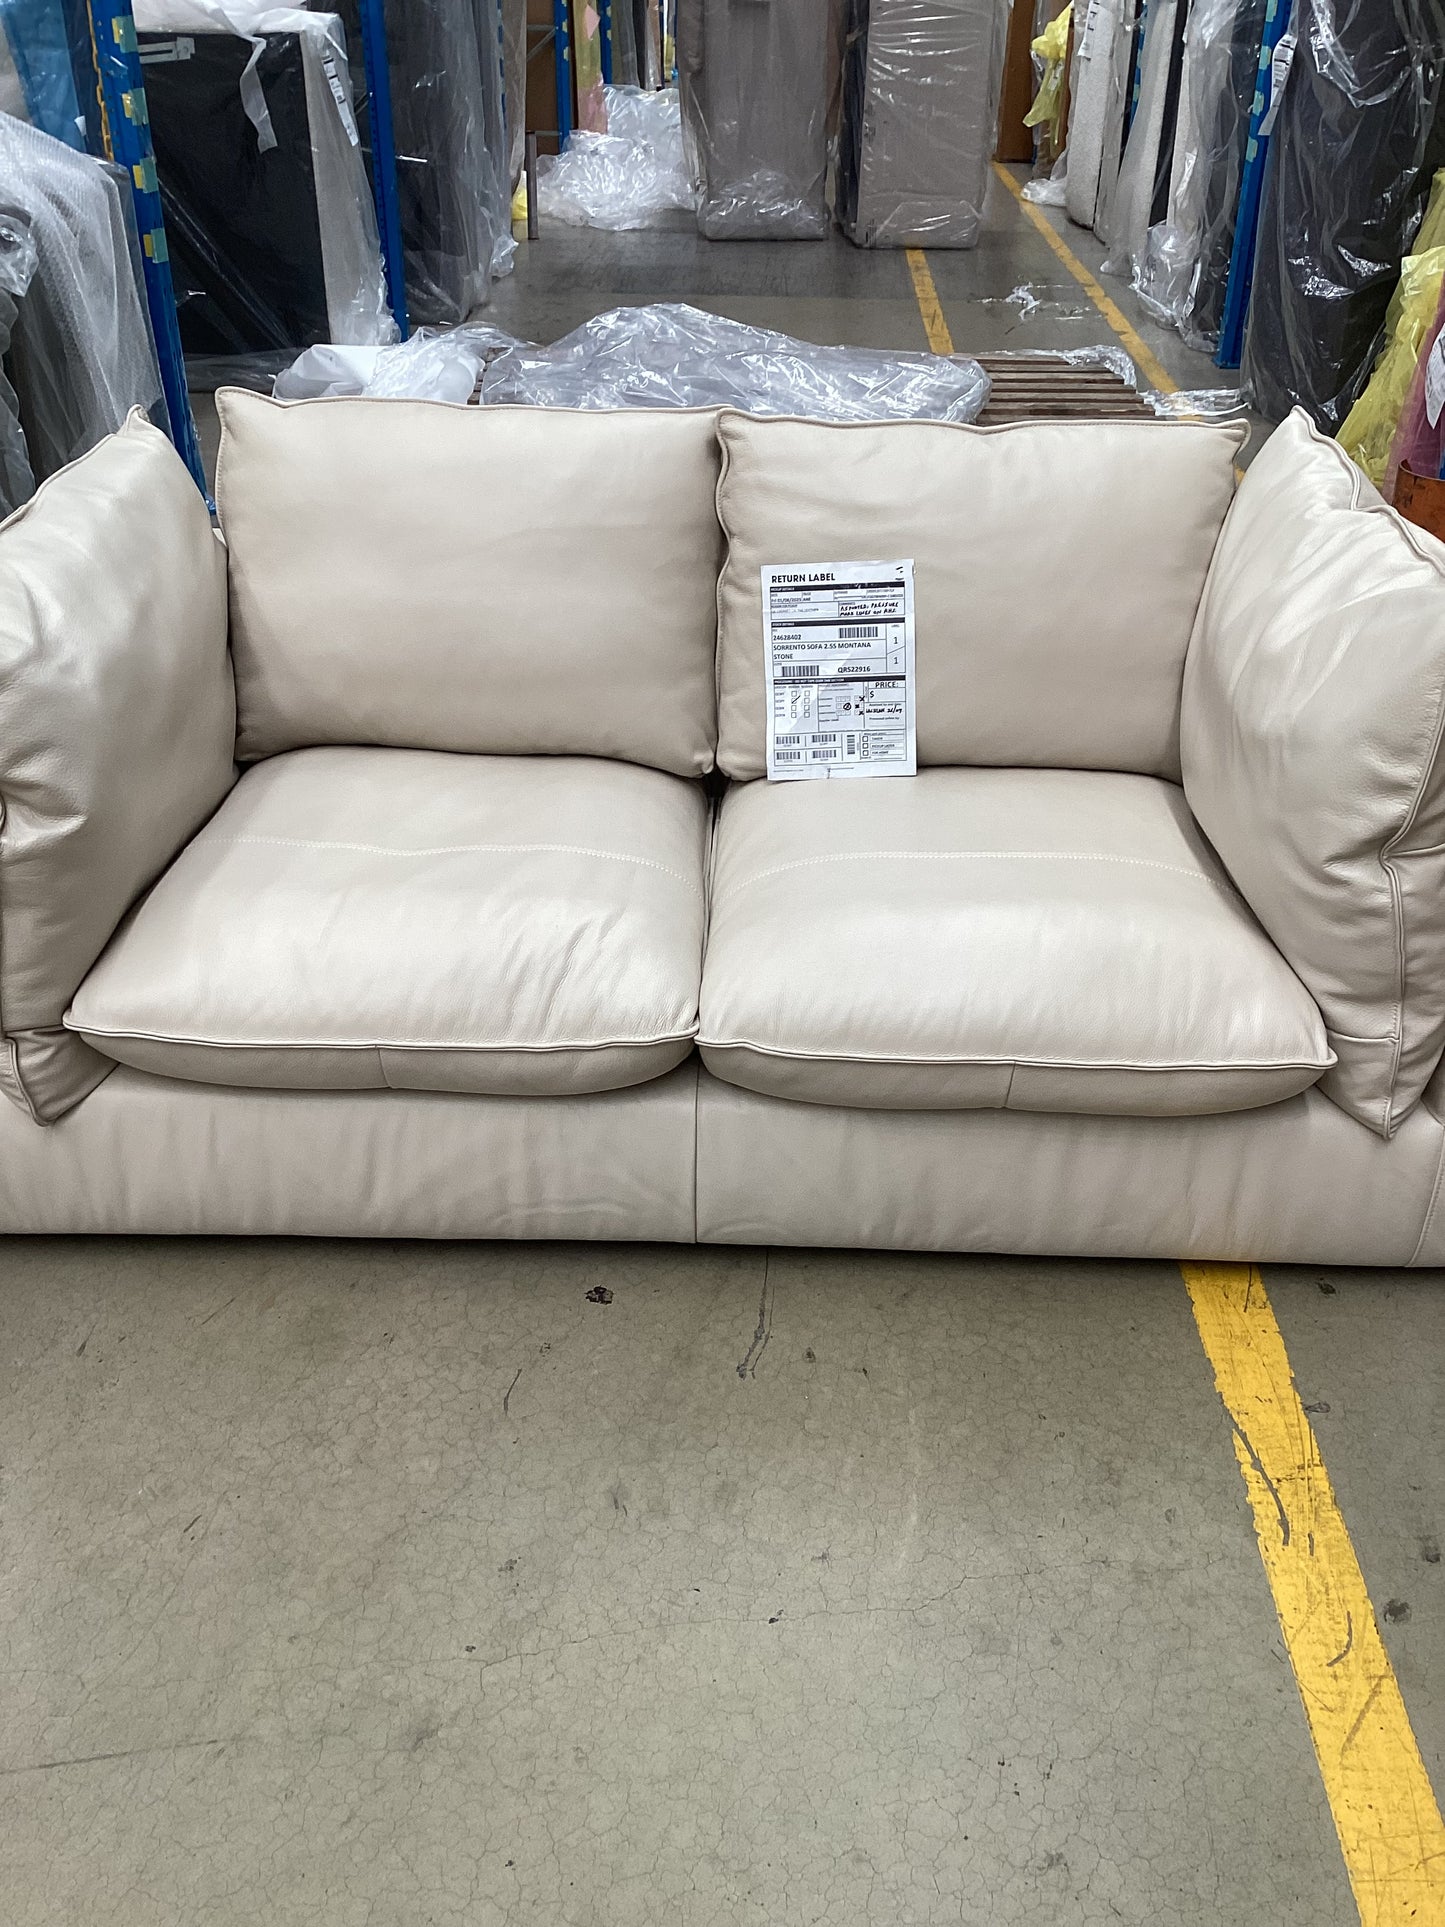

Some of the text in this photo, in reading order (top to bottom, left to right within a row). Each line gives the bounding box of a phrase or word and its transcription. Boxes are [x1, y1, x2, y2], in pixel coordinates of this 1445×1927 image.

[771, 573, 836, 583] RETURN LABEL
[893, 636, 898, 644] 1
[893, 656, 898, 664] 1
